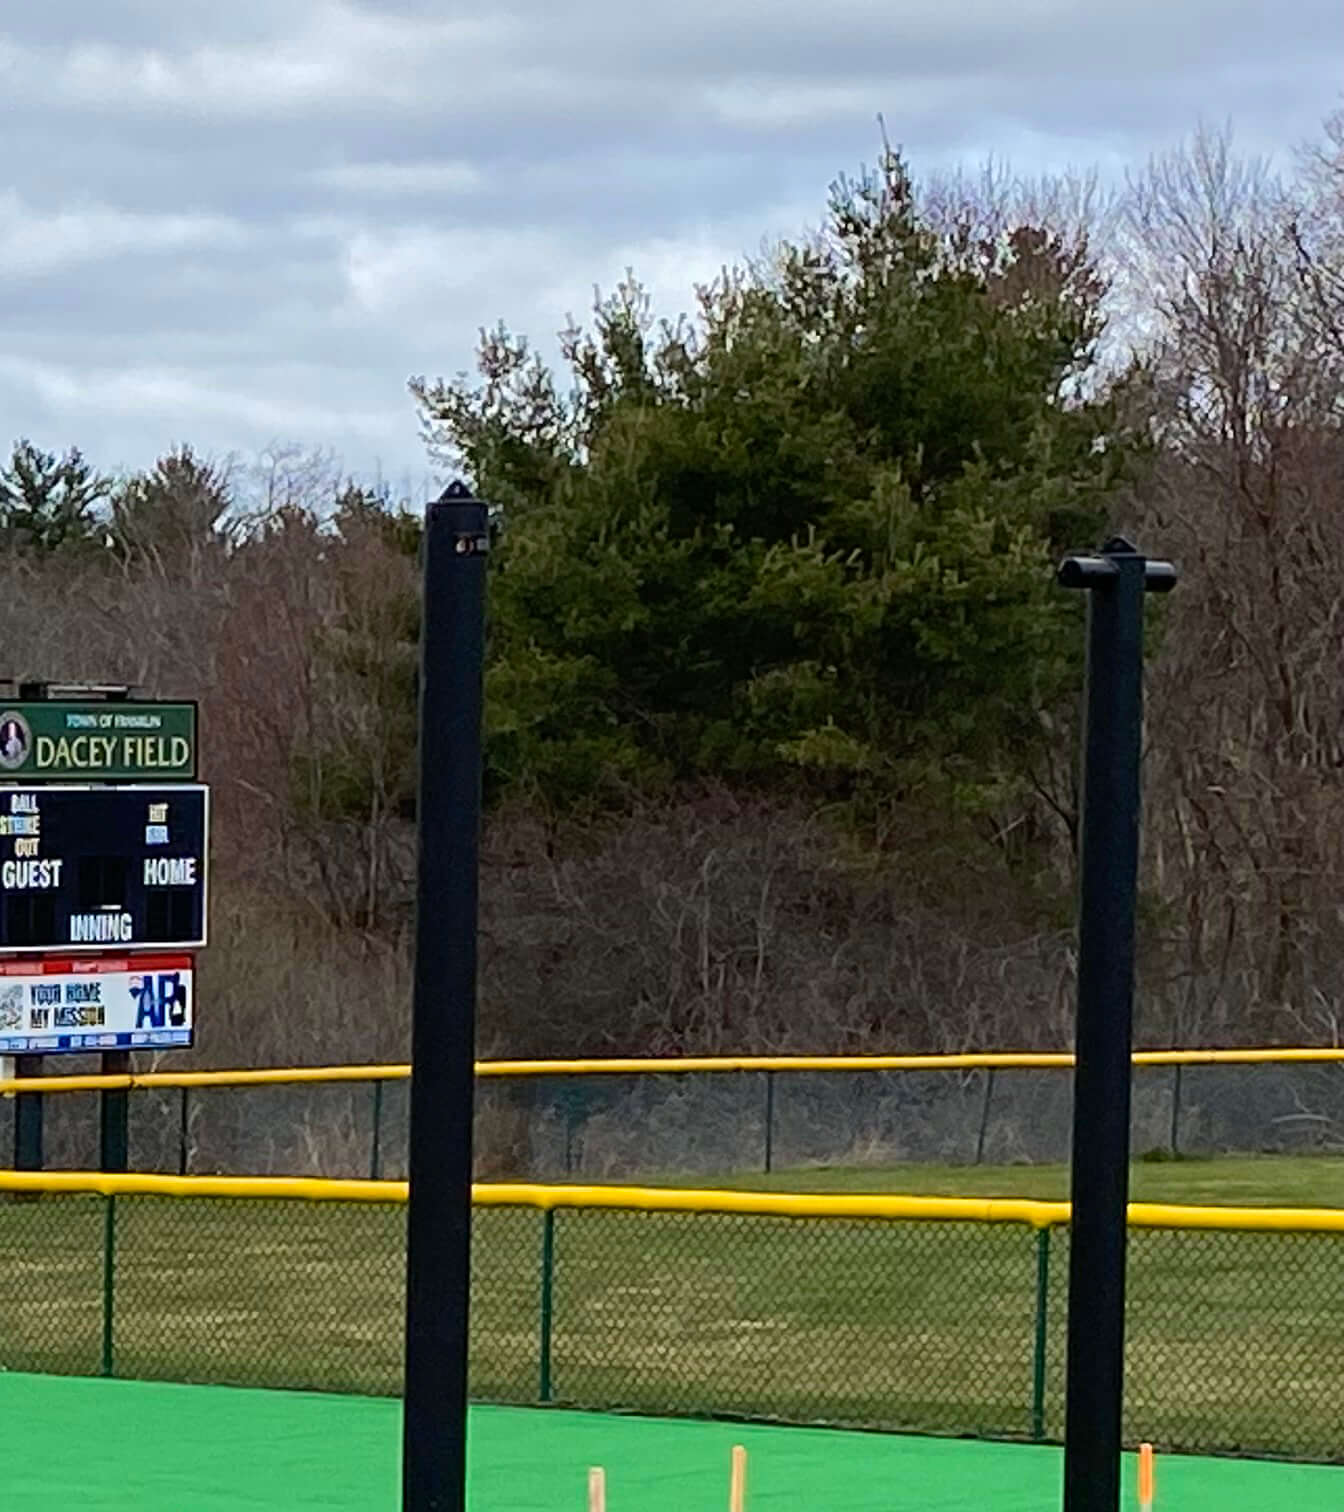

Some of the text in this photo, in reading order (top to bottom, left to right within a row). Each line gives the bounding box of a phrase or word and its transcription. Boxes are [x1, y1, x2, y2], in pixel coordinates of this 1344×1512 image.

[37, 736, 189, 768] DACEY FIELD
[14, 837, 40, 857] OUT
[2, 858, 197, 889] GUEST HOME
[70, 913, 132, 942] INNING
[30, 1008, 49, 1029] MY
